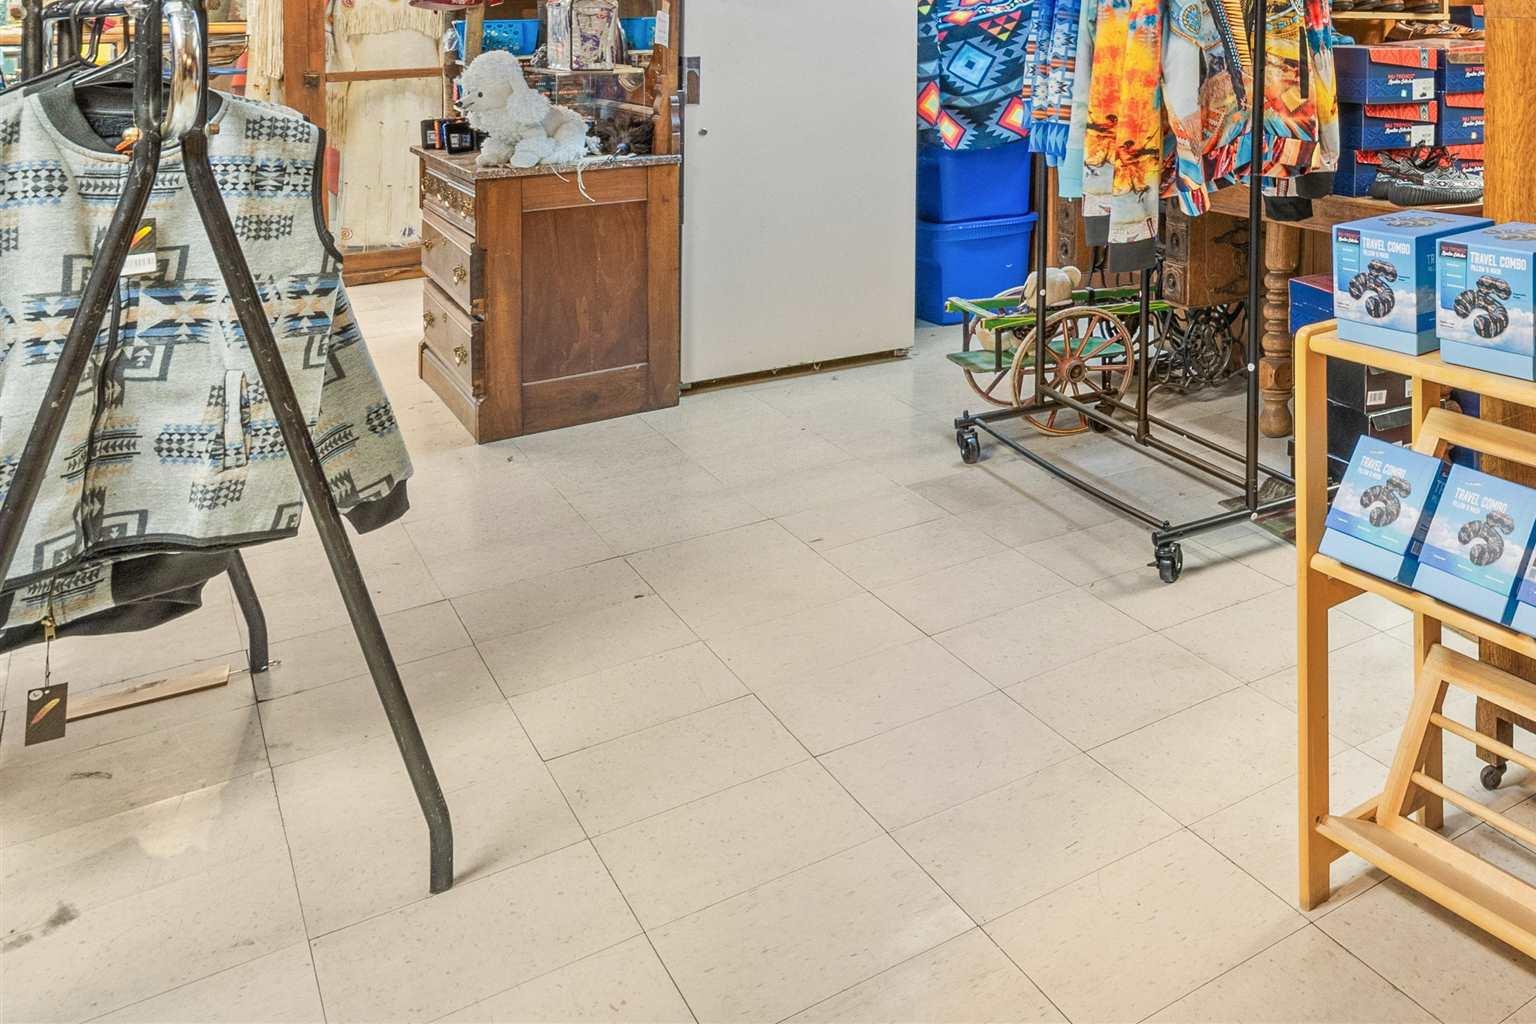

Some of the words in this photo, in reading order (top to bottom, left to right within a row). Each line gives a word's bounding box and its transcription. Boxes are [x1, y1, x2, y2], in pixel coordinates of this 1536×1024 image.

[1362, 236, 1385, 252] TRAVEL
[1387, 240, 1410, 255] COMBO
[1470, 251, 1498, 266] TRAVEL
[1500, 255, 1527, 271] COMBO
[1360, 455, 1382, 473] TRAVEL
[1455, 487, 1480, 506] TRAVEL
